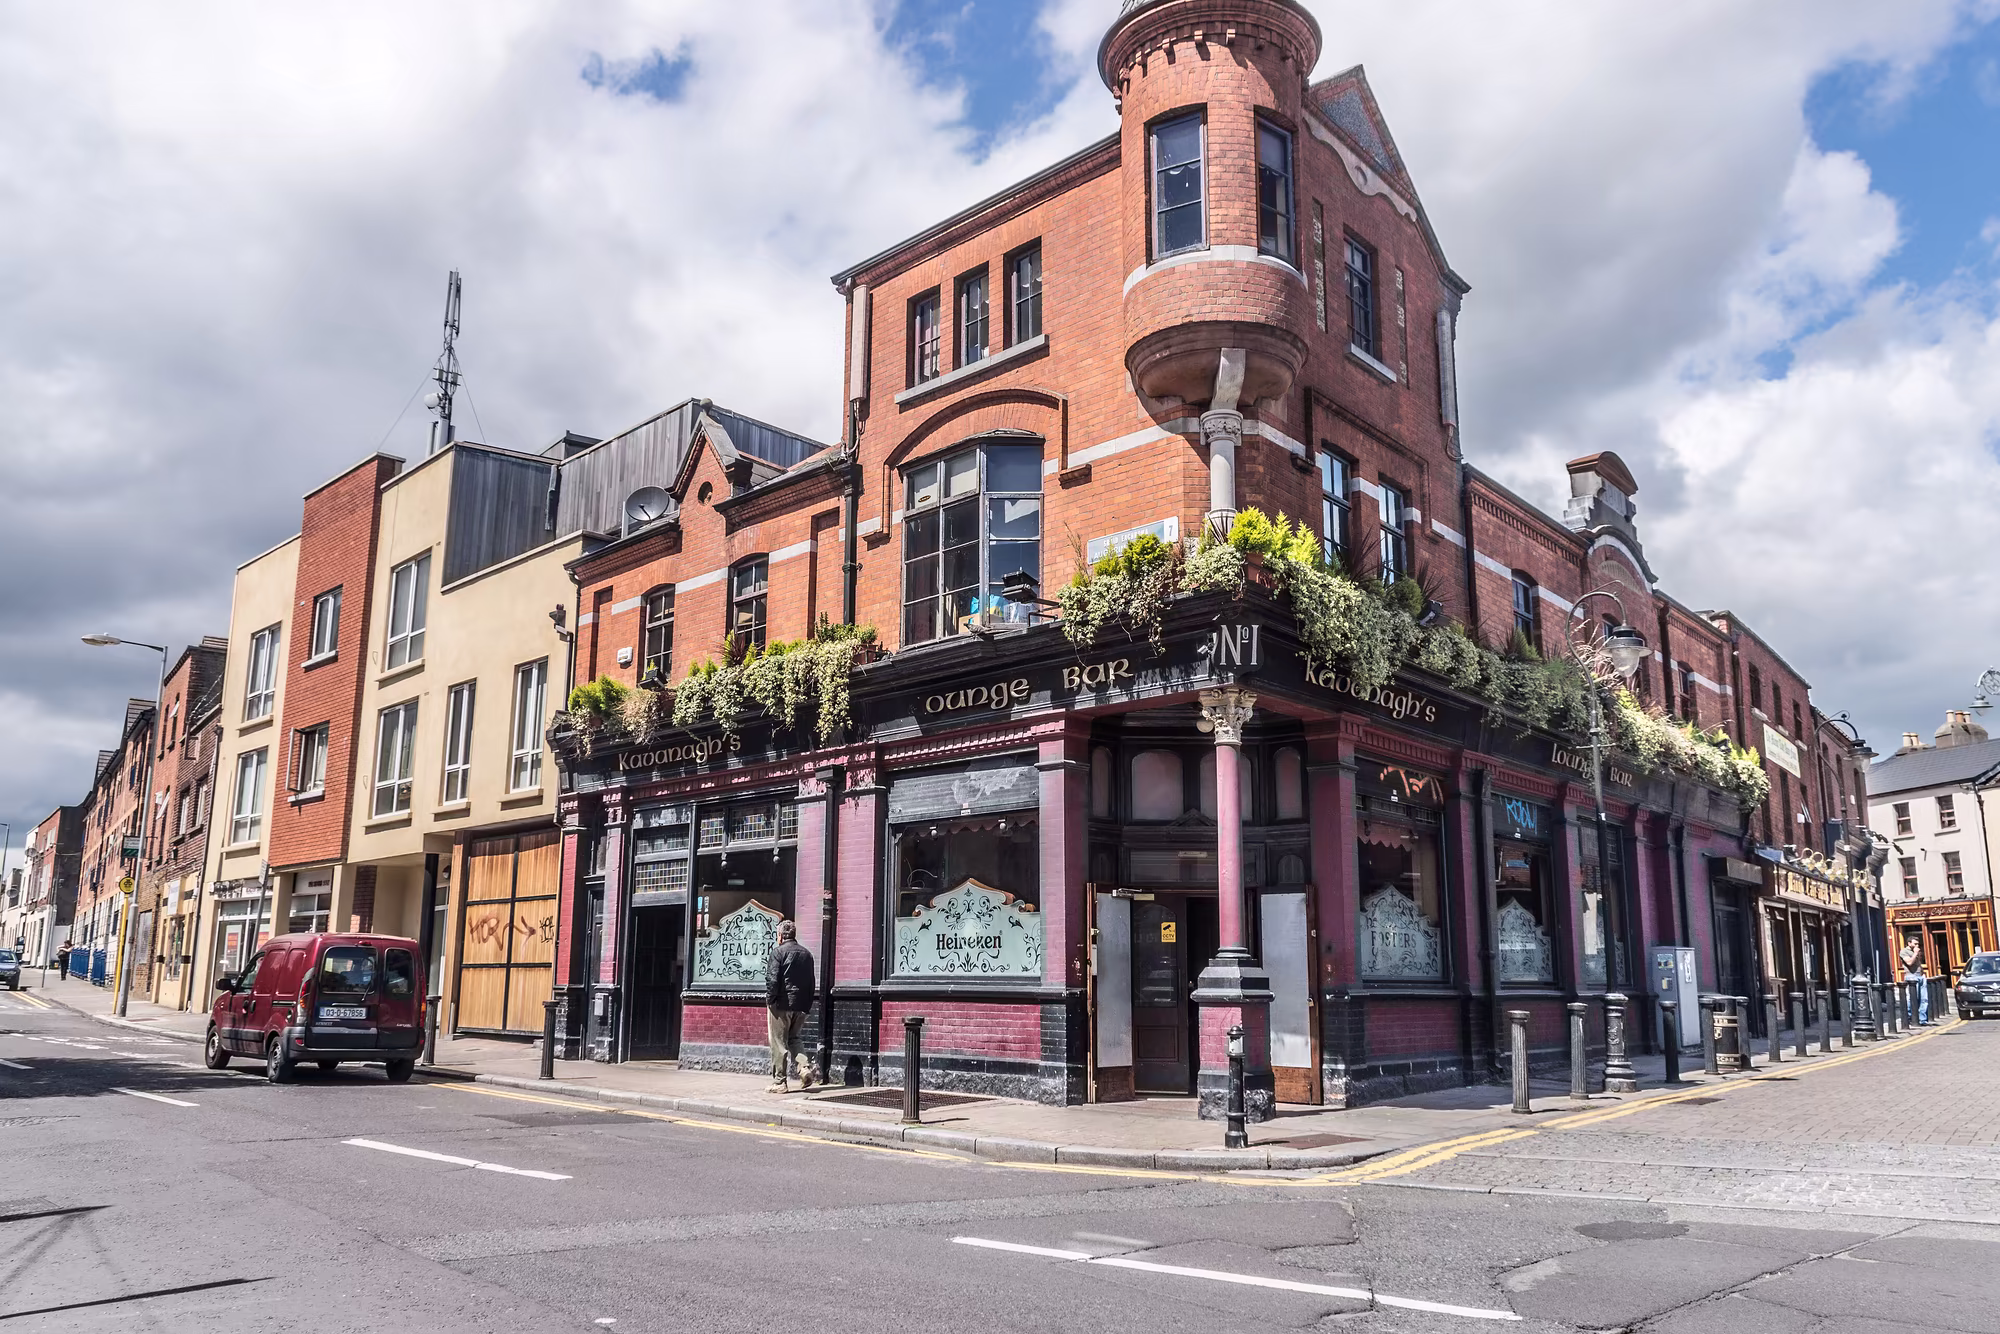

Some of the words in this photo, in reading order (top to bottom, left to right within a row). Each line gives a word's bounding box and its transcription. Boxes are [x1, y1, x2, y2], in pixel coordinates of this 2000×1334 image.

[1168, 525, 1174, 537] 7
[618, 732, 741, 771] Kavanagh's
[1551, 743, 1594, 779] Loung
[1609, 766, 1633, 788] BAR
[721, 941, 775, 957] PEACOCK
[936, 932, 1003, 951] Heineken
[1370, 930, 1417, 949] FOSTERS
